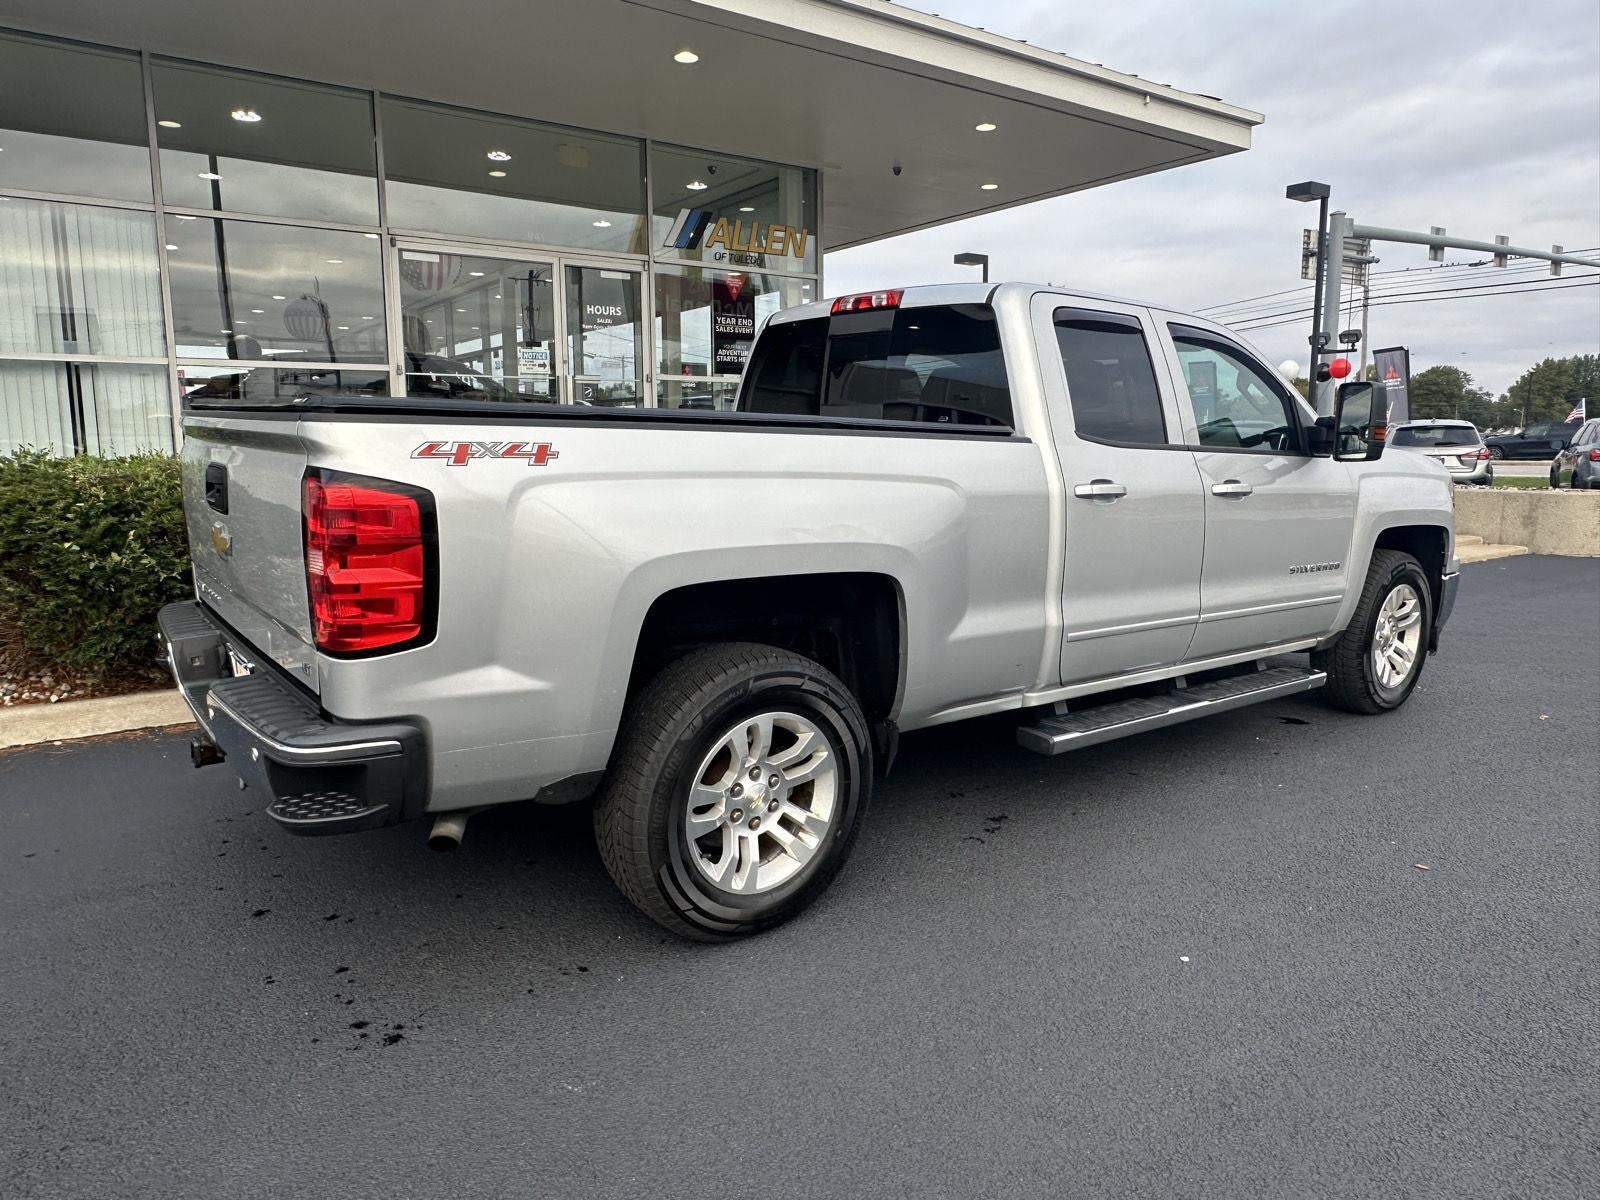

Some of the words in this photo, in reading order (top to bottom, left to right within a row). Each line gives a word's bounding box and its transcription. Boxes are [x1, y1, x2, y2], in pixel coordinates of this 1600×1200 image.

[705, 216, 808, 258] ALLEN
[714, 252, 727, 261] OF
[586, 304, 622, 316] HOURS
[716, 316, 736, 325] YEAR
[737, 318, 753, 326] END
[715, 325, 734, 333] SALES
[522, 351, 547, 360] NOTICE
[716, 355, 738, 363] STARTS
[1289, 561, 1341, 575] SILVERADO
